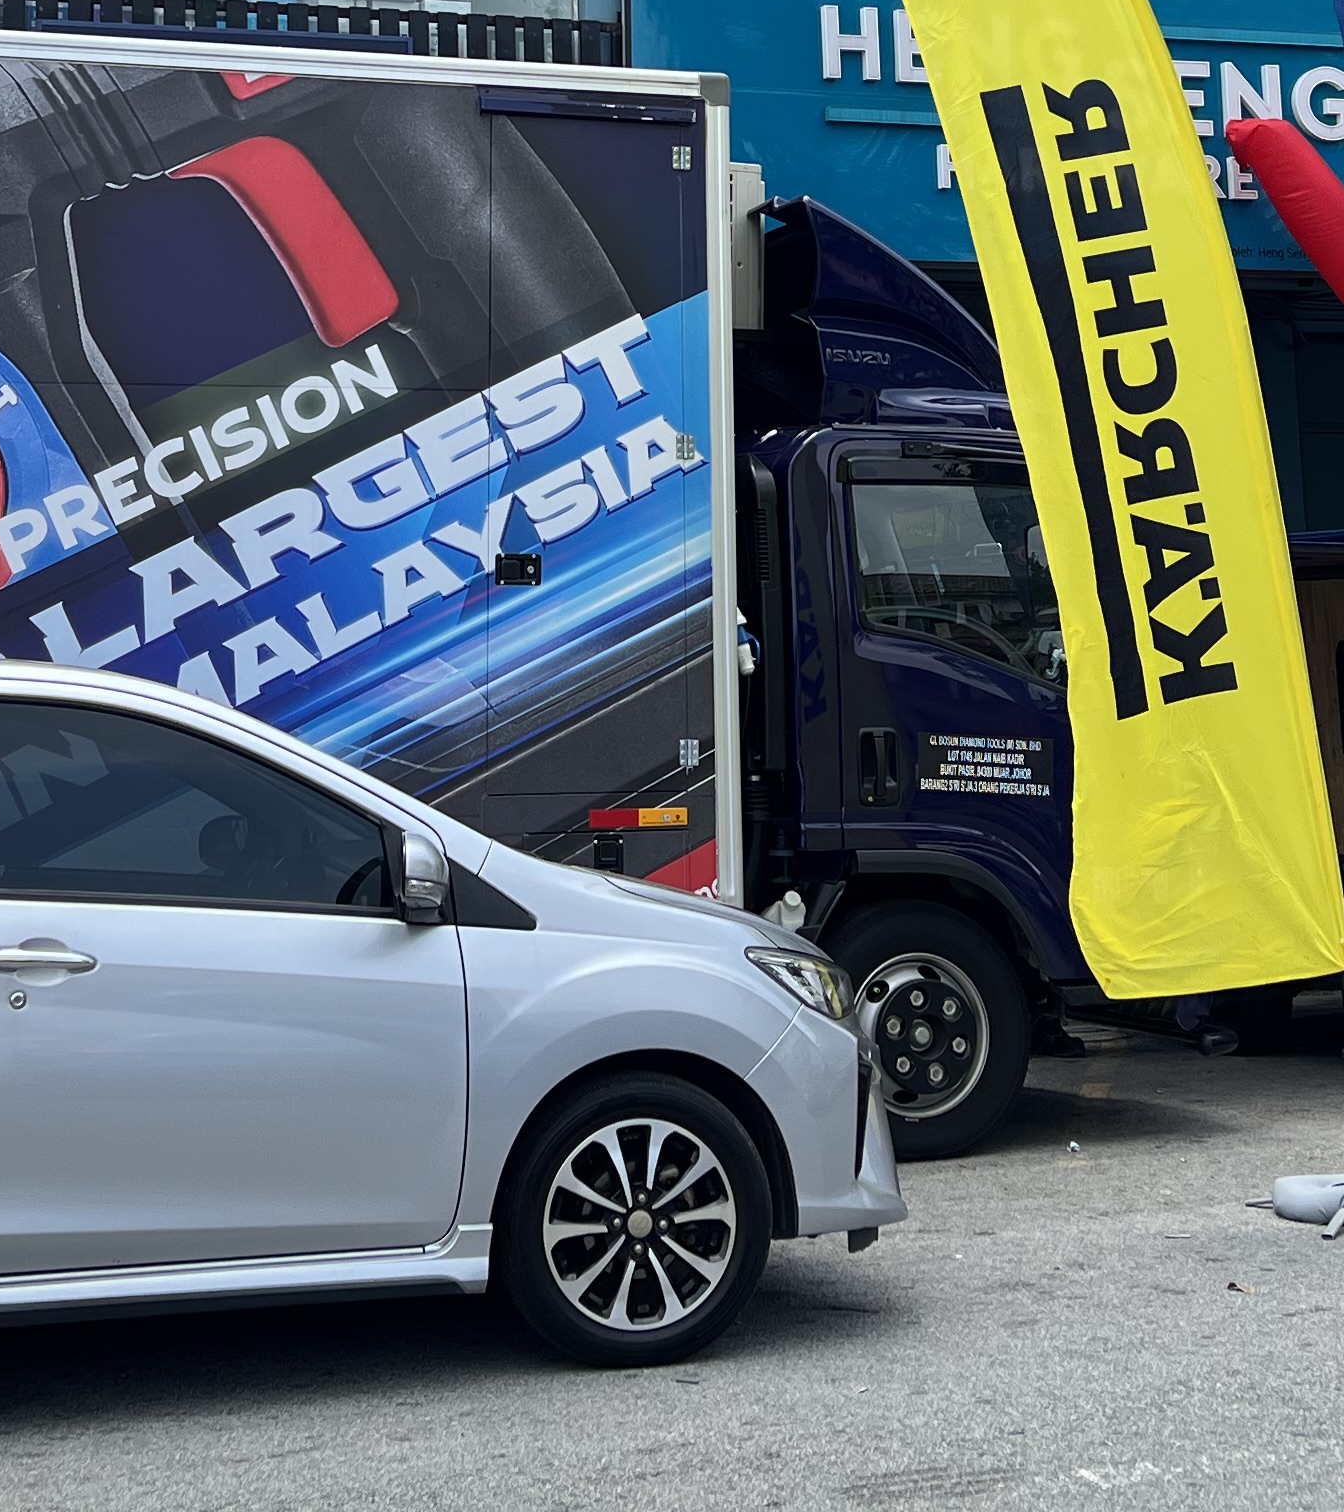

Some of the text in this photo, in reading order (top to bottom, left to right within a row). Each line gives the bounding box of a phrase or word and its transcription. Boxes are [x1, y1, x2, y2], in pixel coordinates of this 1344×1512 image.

[1259, 247, 1284, 261] Heng
[825, 346, 892, 368] ISUZU
[29, 314, 651, 670] LARGEST
